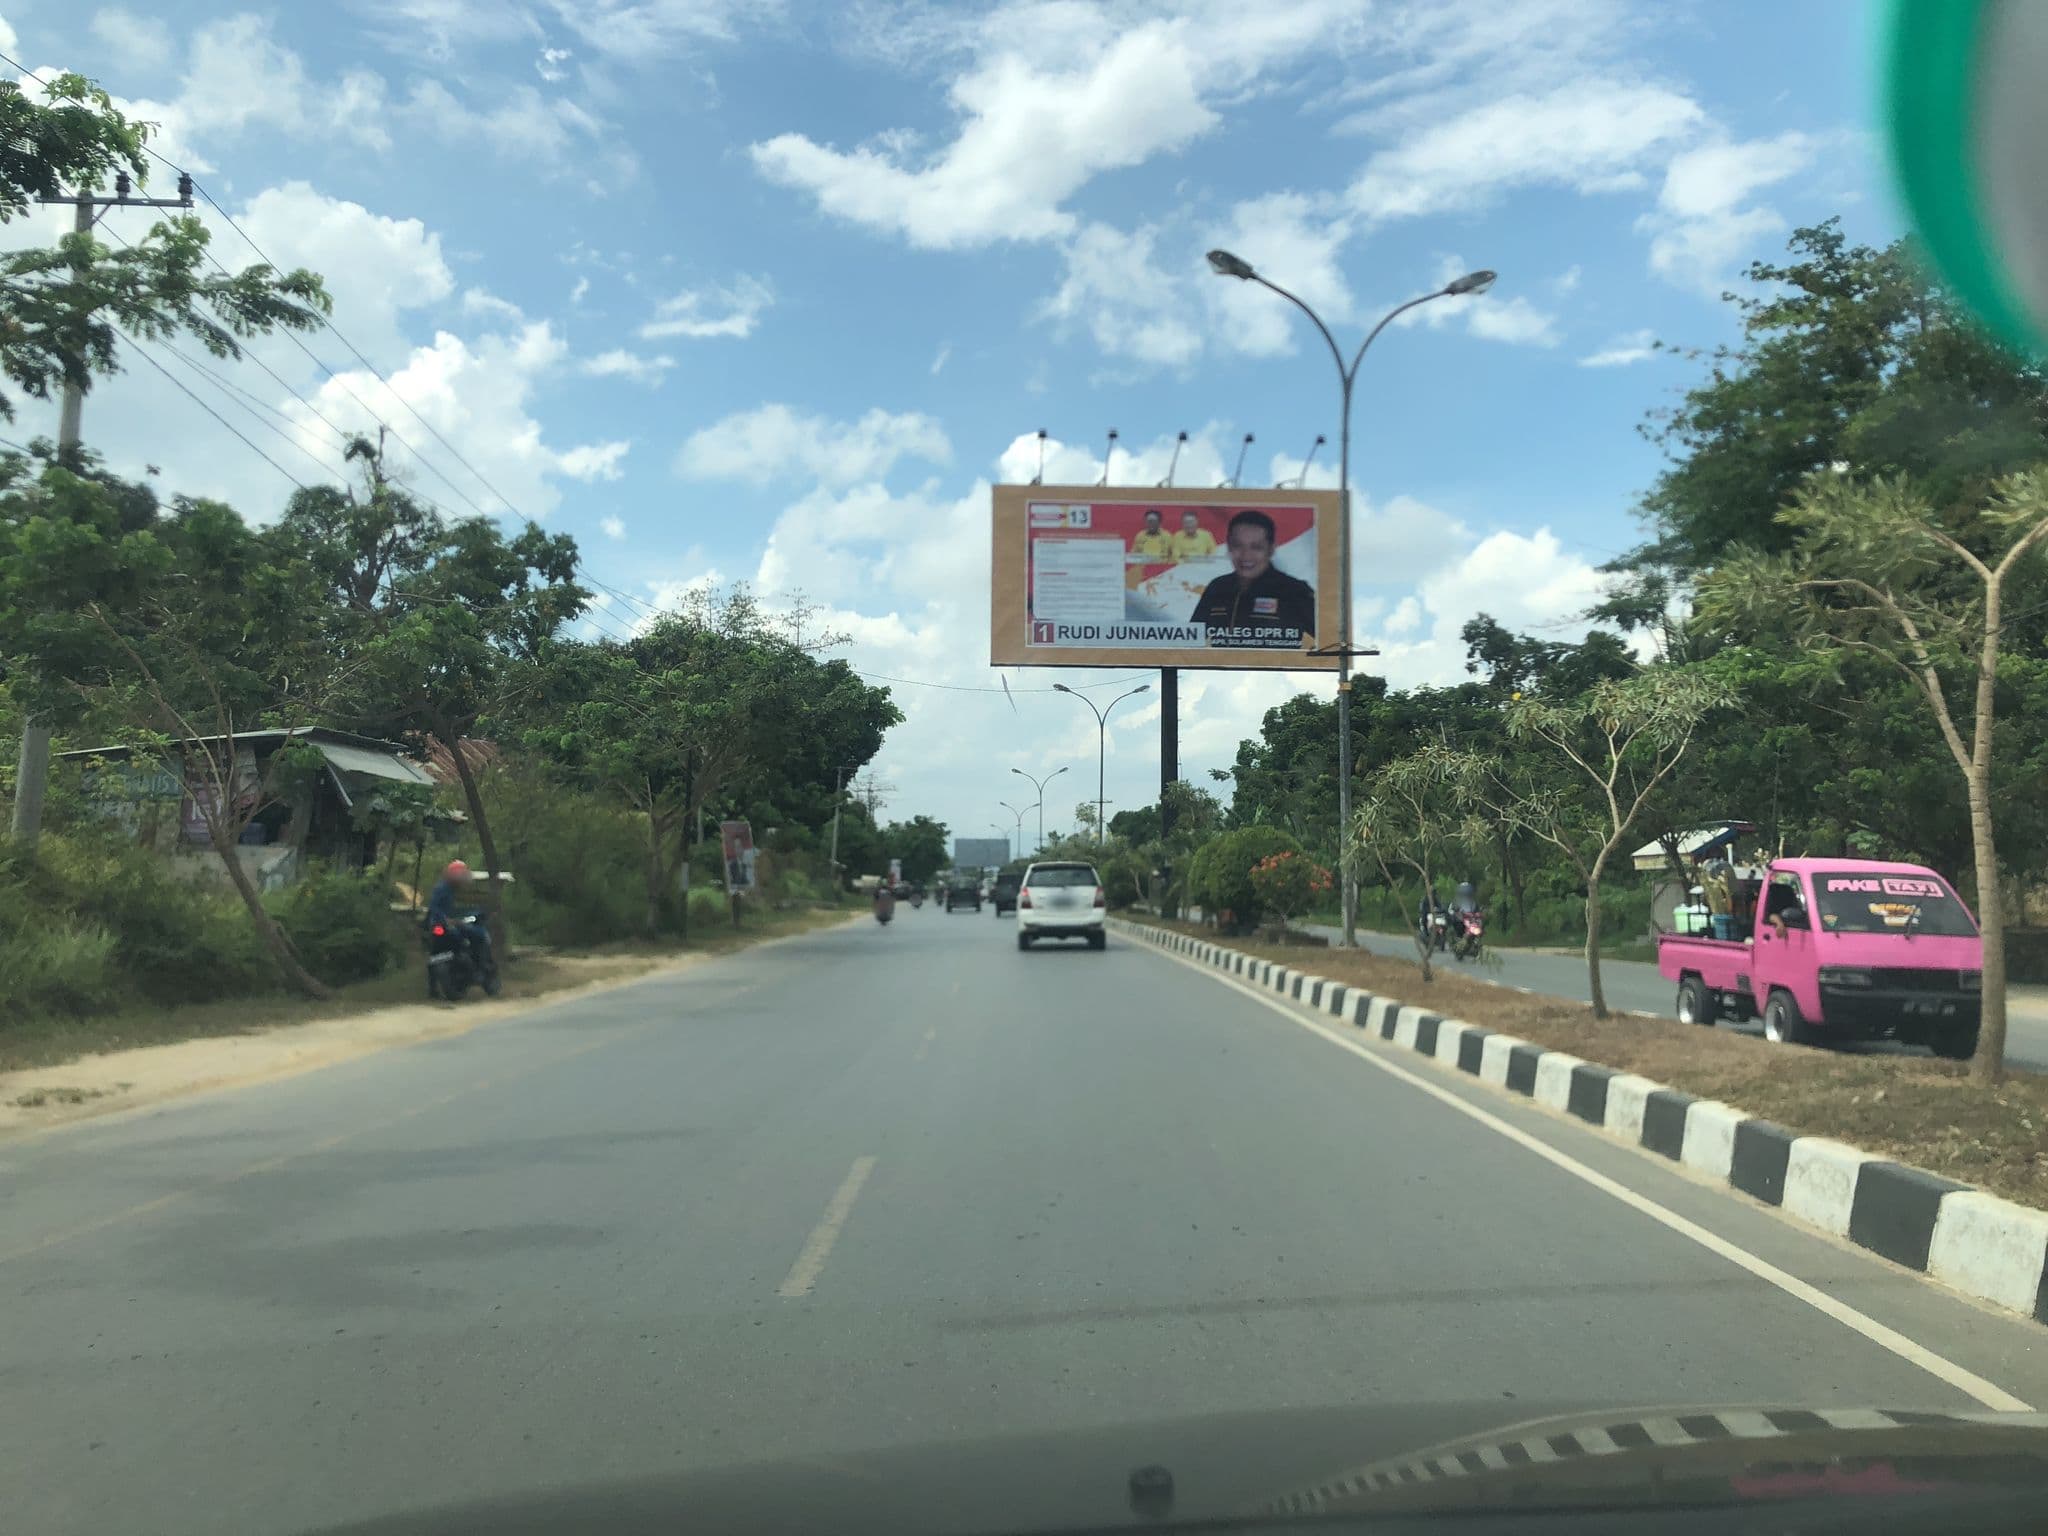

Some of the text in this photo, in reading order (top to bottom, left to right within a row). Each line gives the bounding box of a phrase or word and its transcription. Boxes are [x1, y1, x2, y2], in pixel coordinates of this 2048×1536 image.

[1070, 510, 1088, 524] 13
[1038, 623, 1049, 642] 1
[1058, 625, 1198, 641] RUDI JUNIAWAN
[1206, 626, 1300, 639] CALEG DPR RI
[1827, 879, 1940, 896] FAKE TAXI
